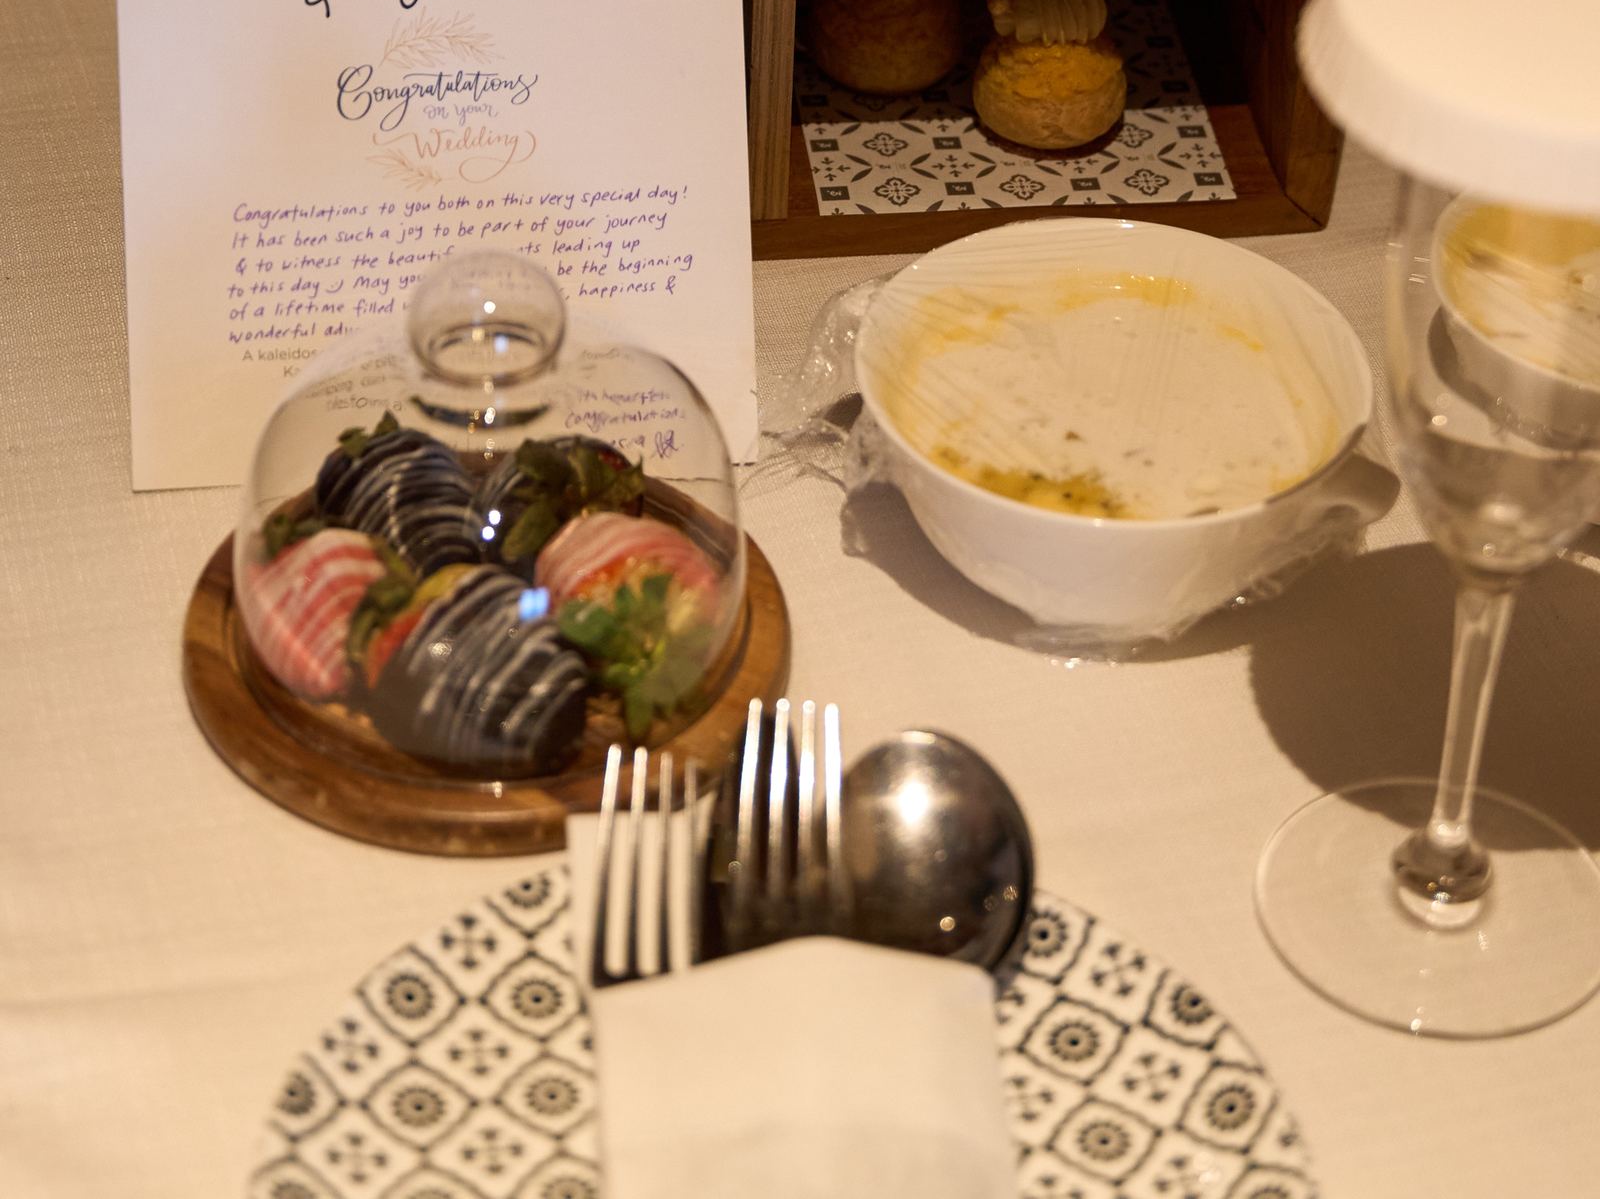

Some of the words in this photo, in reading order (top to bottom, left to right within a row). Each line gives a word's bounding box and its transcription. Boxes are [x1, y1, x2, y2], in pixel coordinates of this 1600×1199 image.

[336, 63, 538, 132] Congratulations
[423, 103, 450, 120] on
[453, 102, 499, 126] your
[372, 126, 537, 184] Wedding
[232, 202, 368, 229] Congratulations
[379, 201, 395, 215] to
[404, 200, 430, 217] you
[438, 194, 470, 211] both
[476, 198, 495, 210] on
[503, 191, 534, 207] this
[540, 191, 575, 209] very
[581, 187, 641, 207] special
[647, 184, 688, 205] day!
[256, 230, 283, 248] has
[293, 230, 328, 247] been
[335, 226, 374, 243] such
[380, 229, 390, 240] a
[396, 222, 423, 244] joy
[433, 222, 450, 238] to
[457, 221, 475, 237] be
[481, 219, 524, 240] part
[530, 216, 549, 233] of
[554, 217, 596, 236] your
[603, 212, 668, 234] journey
[227, 284, 244, 299] to
[250, 279, 283, 295] this
[290, 276, 320, 300] day
[352, 275, 390, 296] May
[557, 259, 574, 277] be
[581, 258, 608, 276] the
[618, 253, 693, 274] beginning
[235, 257, 247, 276] &
[256, 257, 273, 273] to
[281, 255, 342, 271] witness
[351, 253, 379, 269] the
[387, 244, 456, 266] beautif
[552, 236, 613, 258] leading
[621, 238, 641, 254] up
[229, 305, 247, 321] of
[253, 306, 265, 318] a
[274, 300, 345, 318] lifetime
[353, 297, 395, 317] filled
[578, 280, 656, 300] happiness
[665, 274, 677, 295] &
[228, 321, 316, 344] wonderful
[242, 348, 254, 362] A
